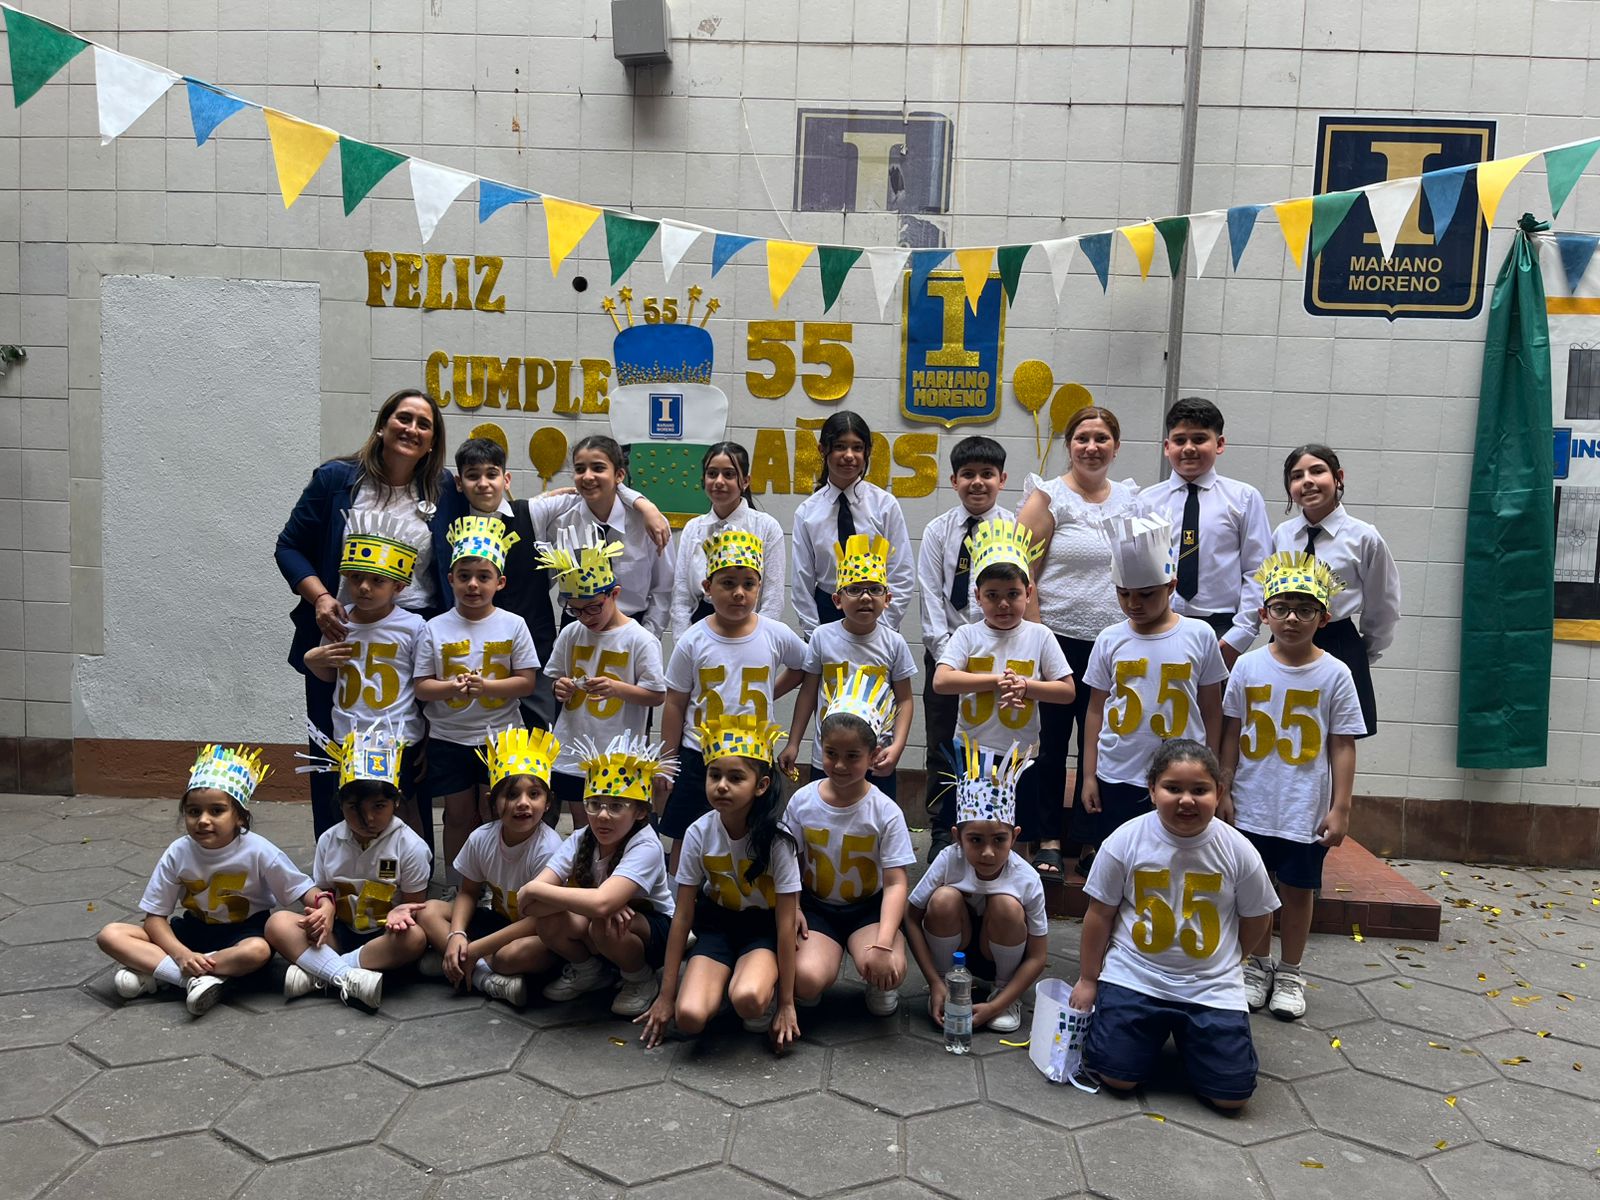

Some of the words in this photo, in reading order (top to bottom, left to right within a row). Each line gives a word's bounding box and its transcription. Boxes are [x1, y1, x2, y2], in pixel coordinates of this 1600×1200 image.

[364, 251, 506, 313] FELIZ
[1348, 275, 1441, 292] MORENO
[1350, 256, 1443, 273] MARIANO
[643, 296, 679, 324] 55
[925, 280, 980, 367] I
[425, 351, 613, 414] CUMPLE
[745, 320, 854, 401] 55
[912, 370, 990, 389] MARIANO
[658, 398, 673, 421] I
[913, 388, 988, 407] MORENO
[339, 642, 401, 709] 55
[441, 639, 514, 709] 55
[564, 645, 630, 719] 55
[1107, 657, 1192, 738] 55
[1239, 683, 1323, 766] 55
[802, 827, 879, 900] 55
[1131, 868, 1223, 960] 55
